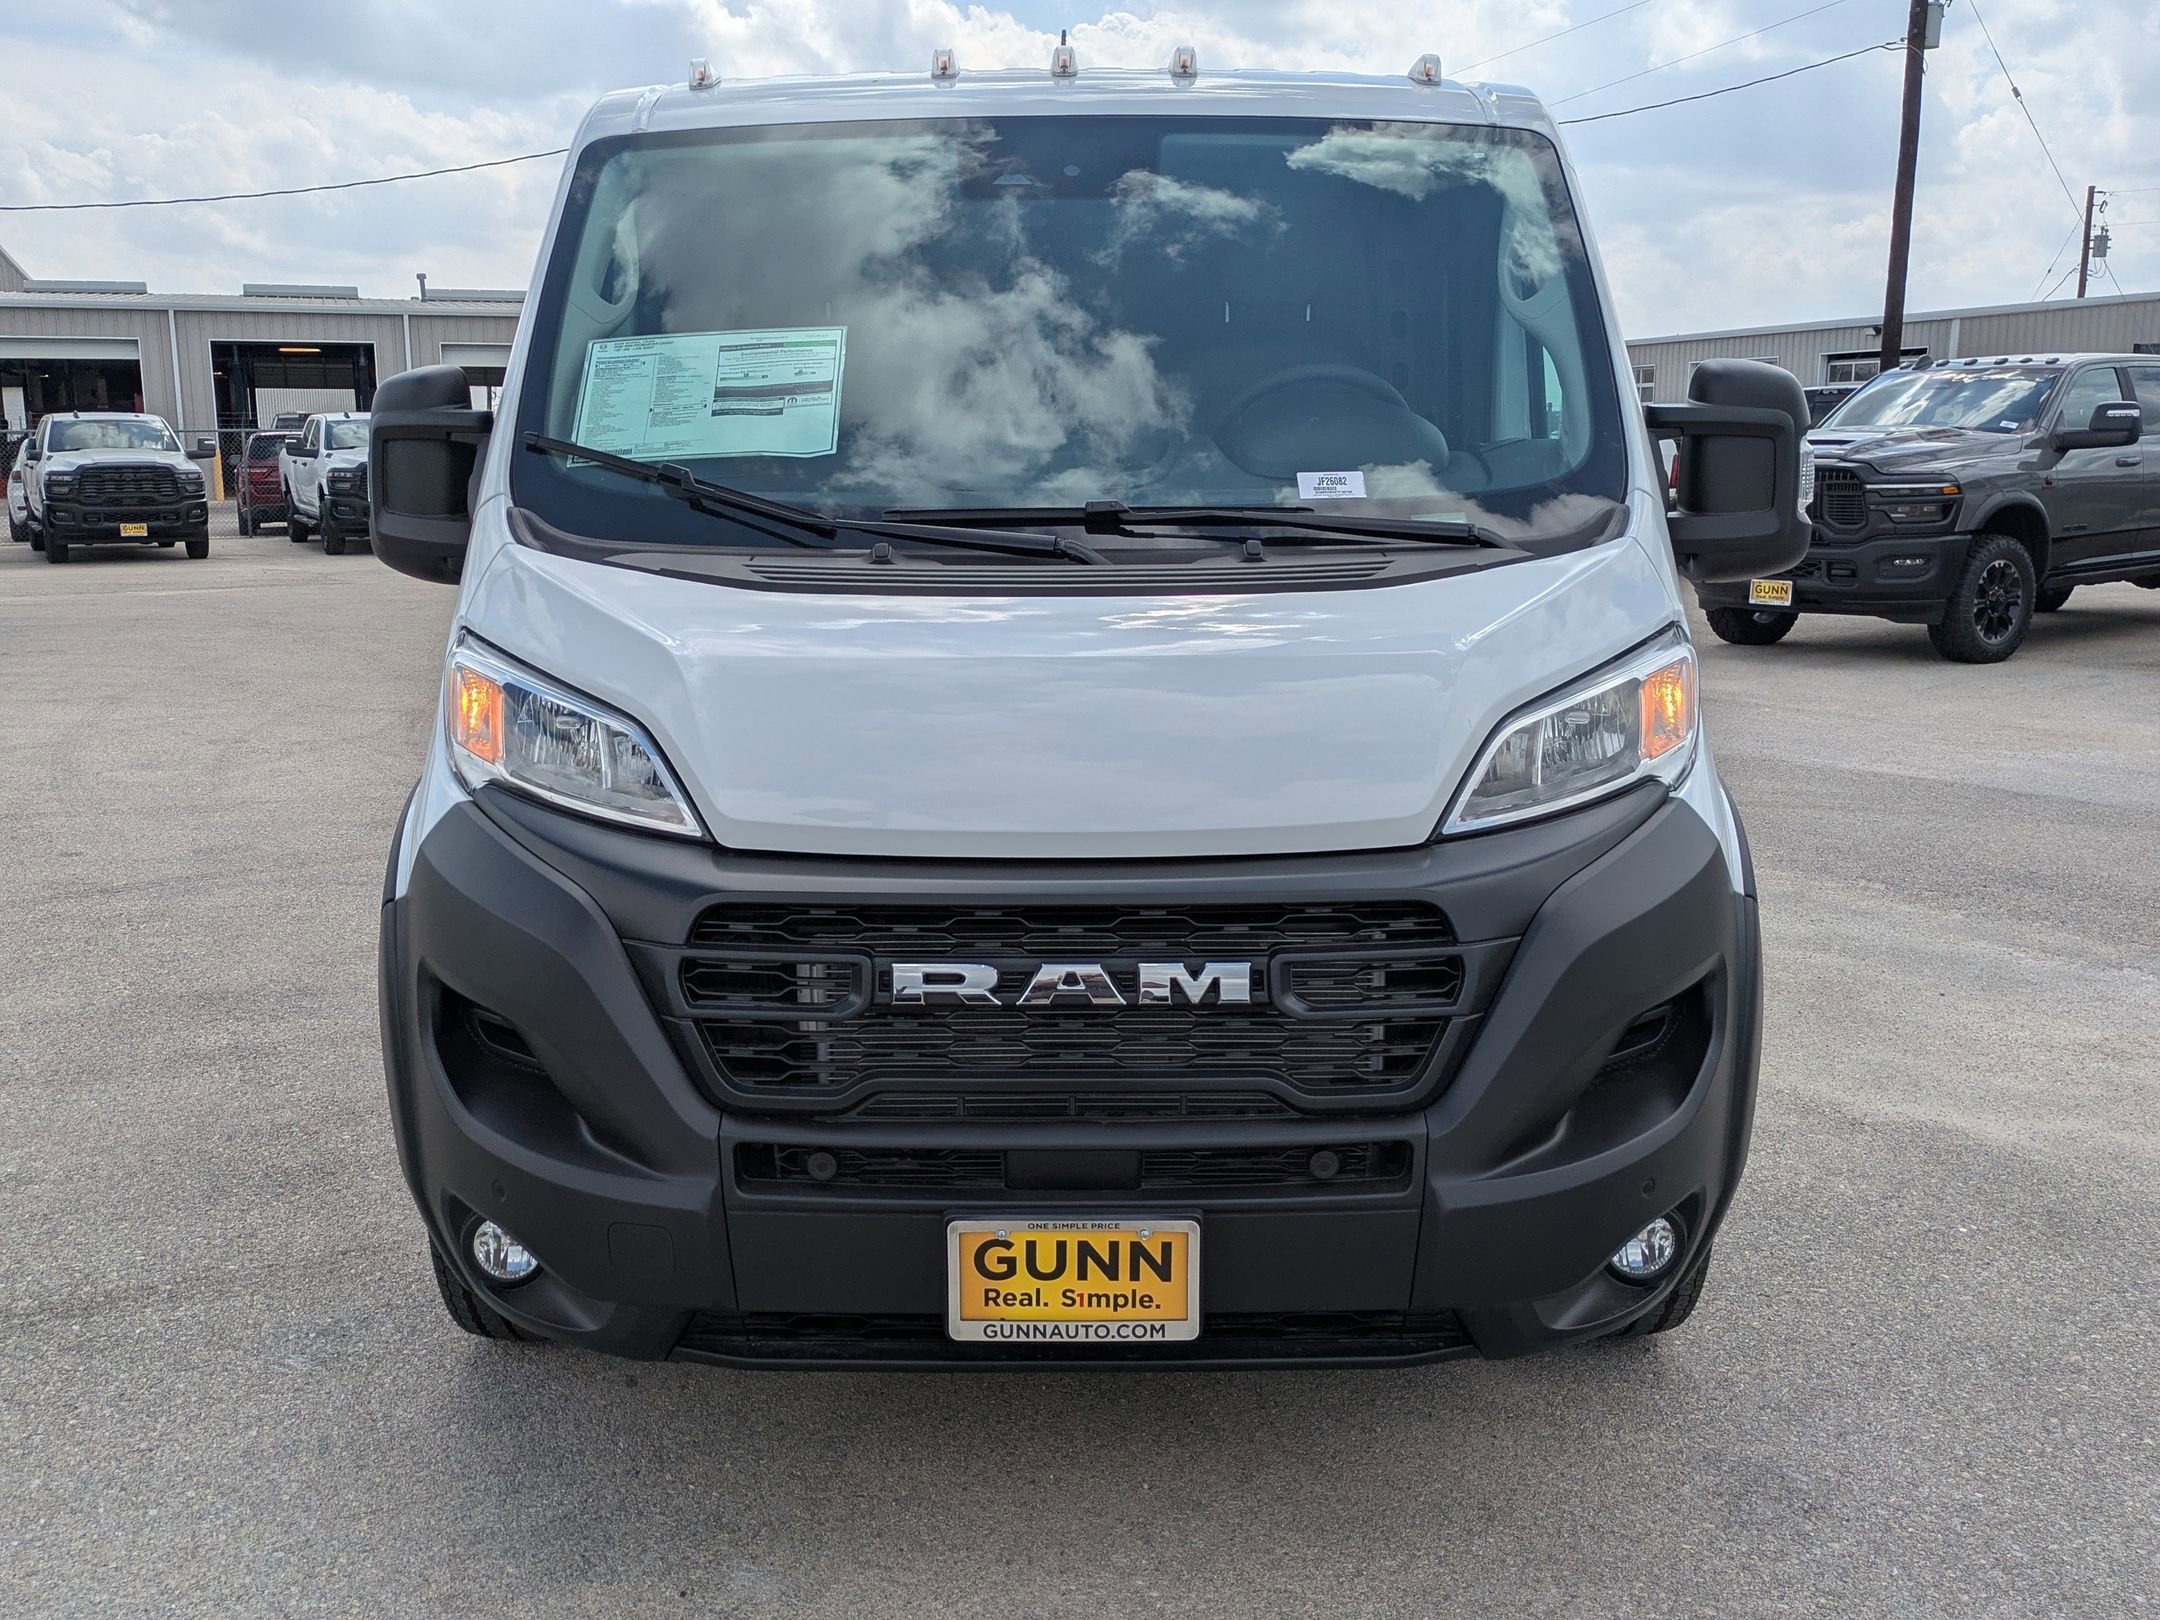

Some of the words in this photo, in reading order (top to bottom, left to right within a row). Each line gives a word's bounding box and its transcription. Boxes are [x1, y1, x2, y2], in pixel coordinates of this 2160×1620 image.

[1755, 585, 1788, 595] GUNN
[891, 963, 1252, 1006] RAM
[1027, 1222, 1049, 1230] ONE
[1052, 1222, 1088, 1230] SIMPLE
[1091, 1222, 1120, 1230] PRICE
[974, 1239, 1172, 1282] GUNN
[984, 1288, 1048, 1307] Real.
[983, 1324, 1166, 1339] GUNNAUTO.COM
